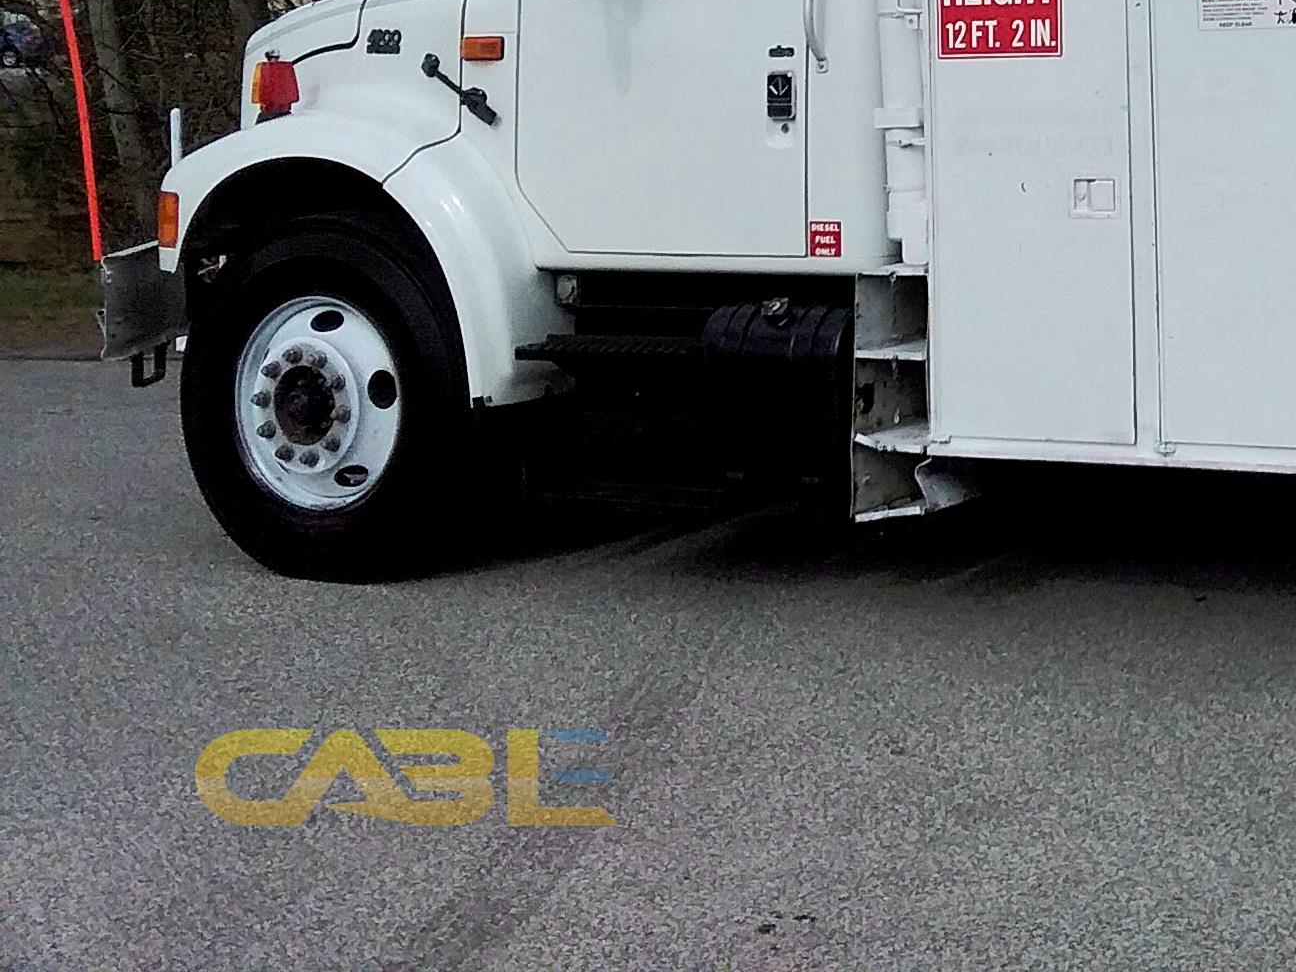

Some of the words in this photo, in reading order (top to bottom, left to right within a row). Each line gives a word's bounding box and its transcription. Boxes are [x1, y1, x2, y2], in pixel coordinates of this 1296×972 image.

[945, 20, 967, 49] 12
[971, 19, 1001, 48] FT.
[1011, 19, 1025, 47] 2
[1030, 18, 1057, 47] IN.
[811, 223, 840, 232] DIESEL
[815, 235, 837, 244] FUEL
[815, 247, 836, 256] ONLY
